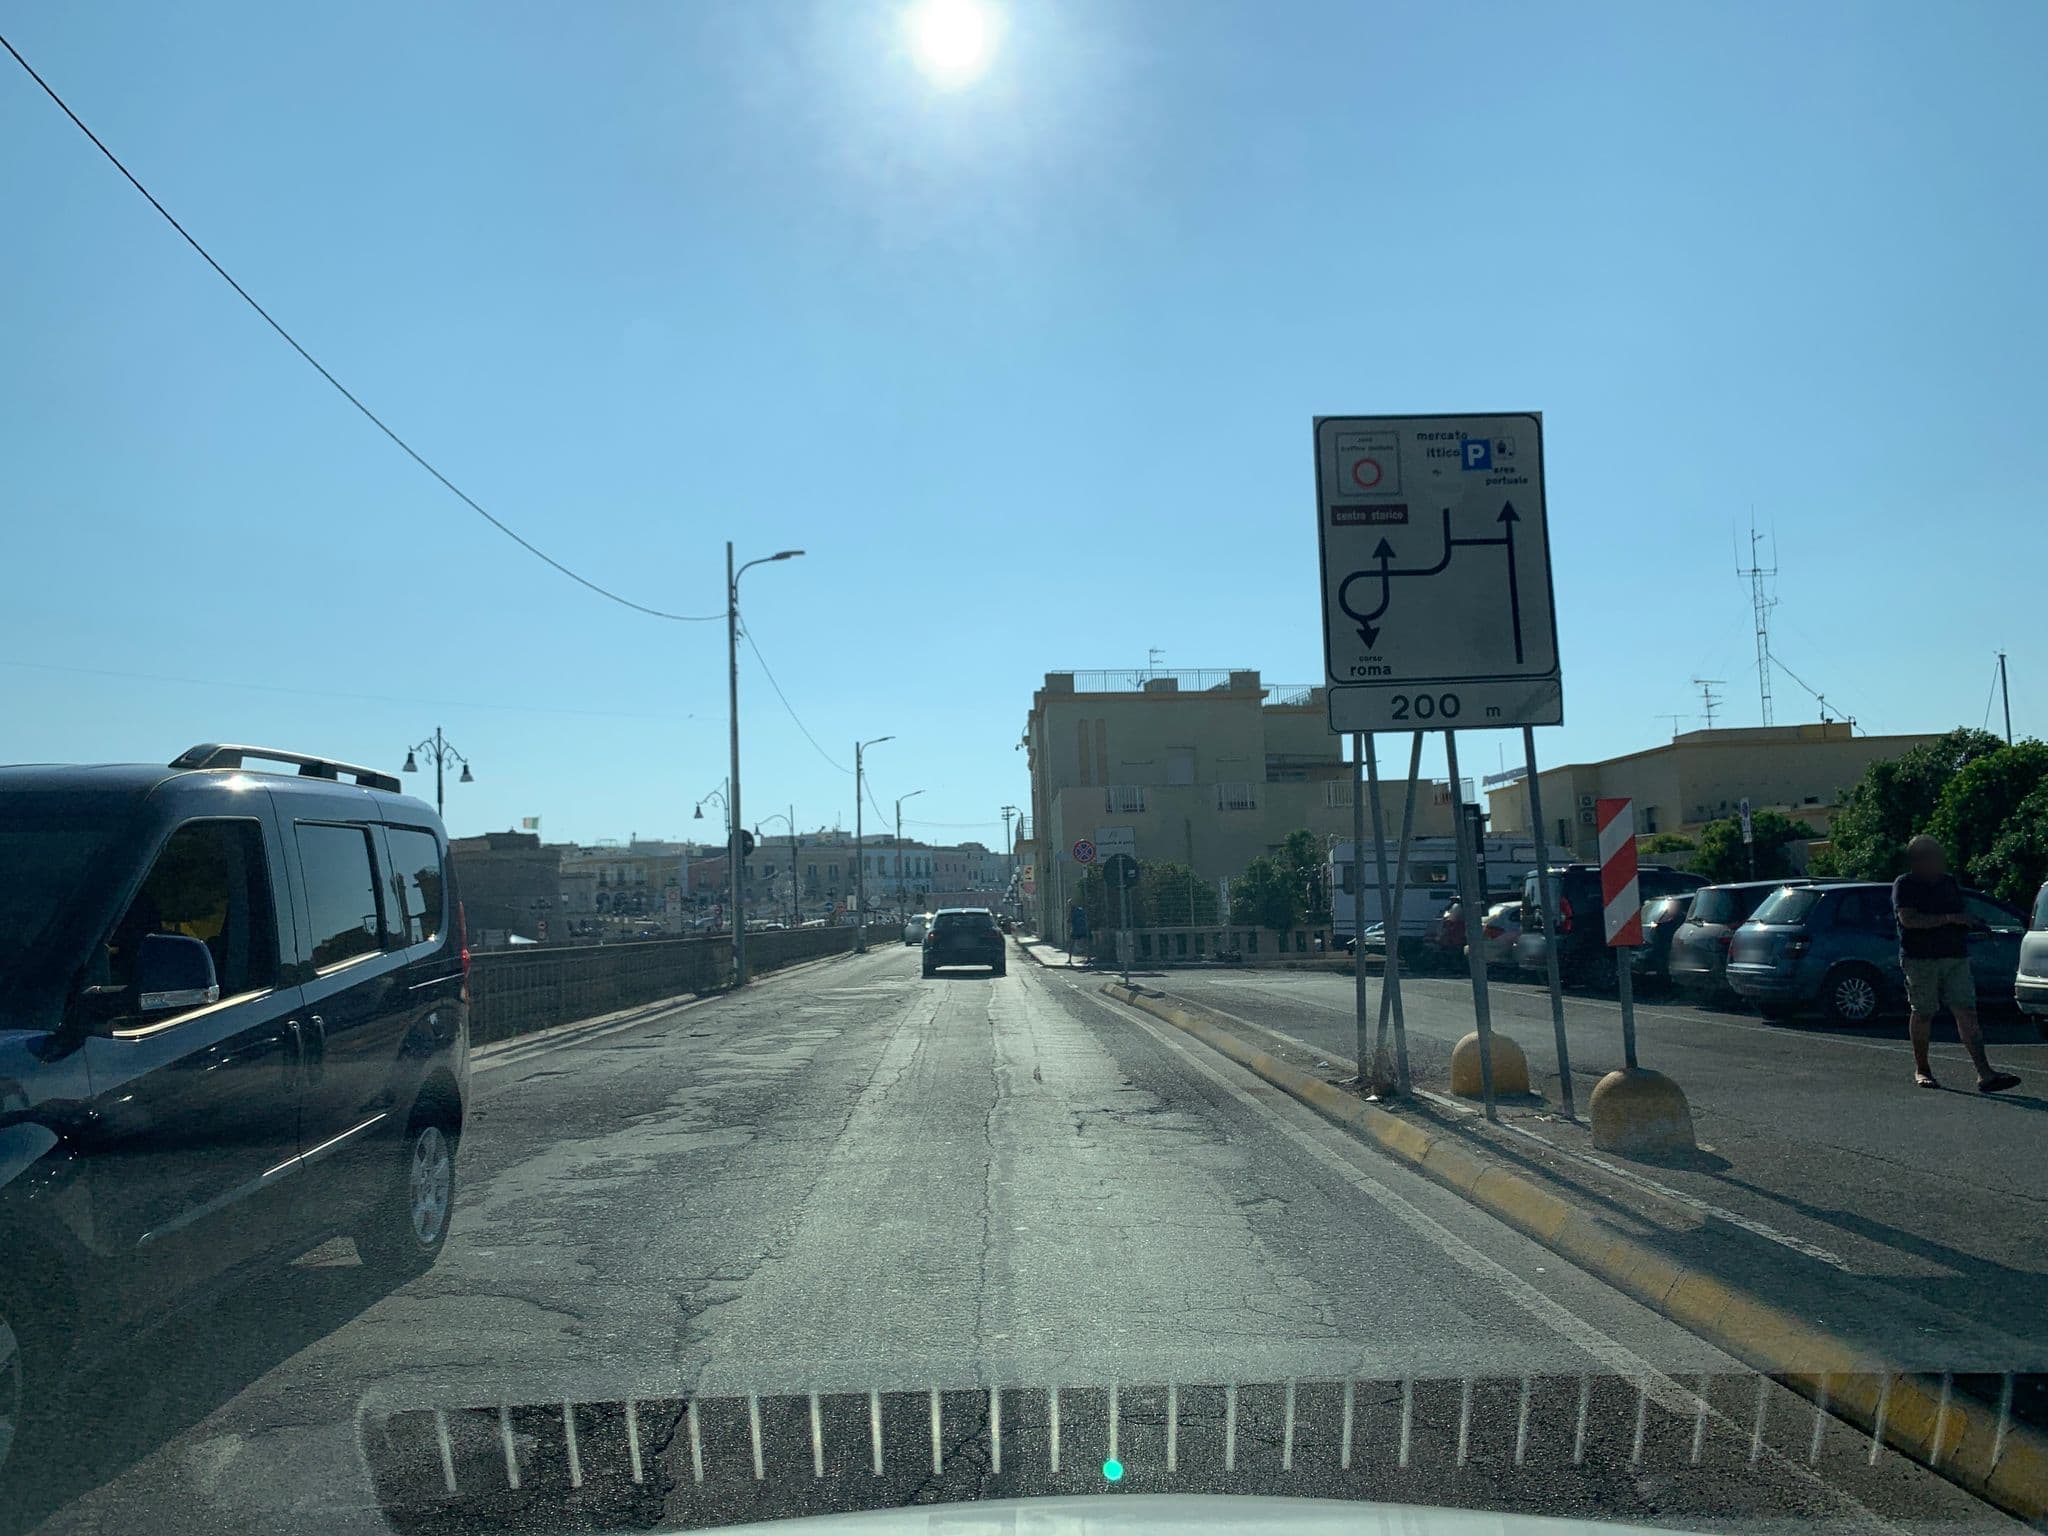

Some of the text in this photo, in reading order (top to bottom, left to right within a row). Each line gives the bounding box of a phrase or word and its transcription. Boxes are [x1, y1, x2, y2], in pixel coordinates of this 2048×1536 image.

[1416, 430, 1468, 441] mercato
[1426, 447, 1461, 458] ittico
[1467, 443, 1485, 466] P
[1485, 476, 1528, 486] portuale
[1336, 509, 1403, 521] centro storico
[1350, 665, 1392, 676] roma
[1391, 693, 1501, 720] 200 m
